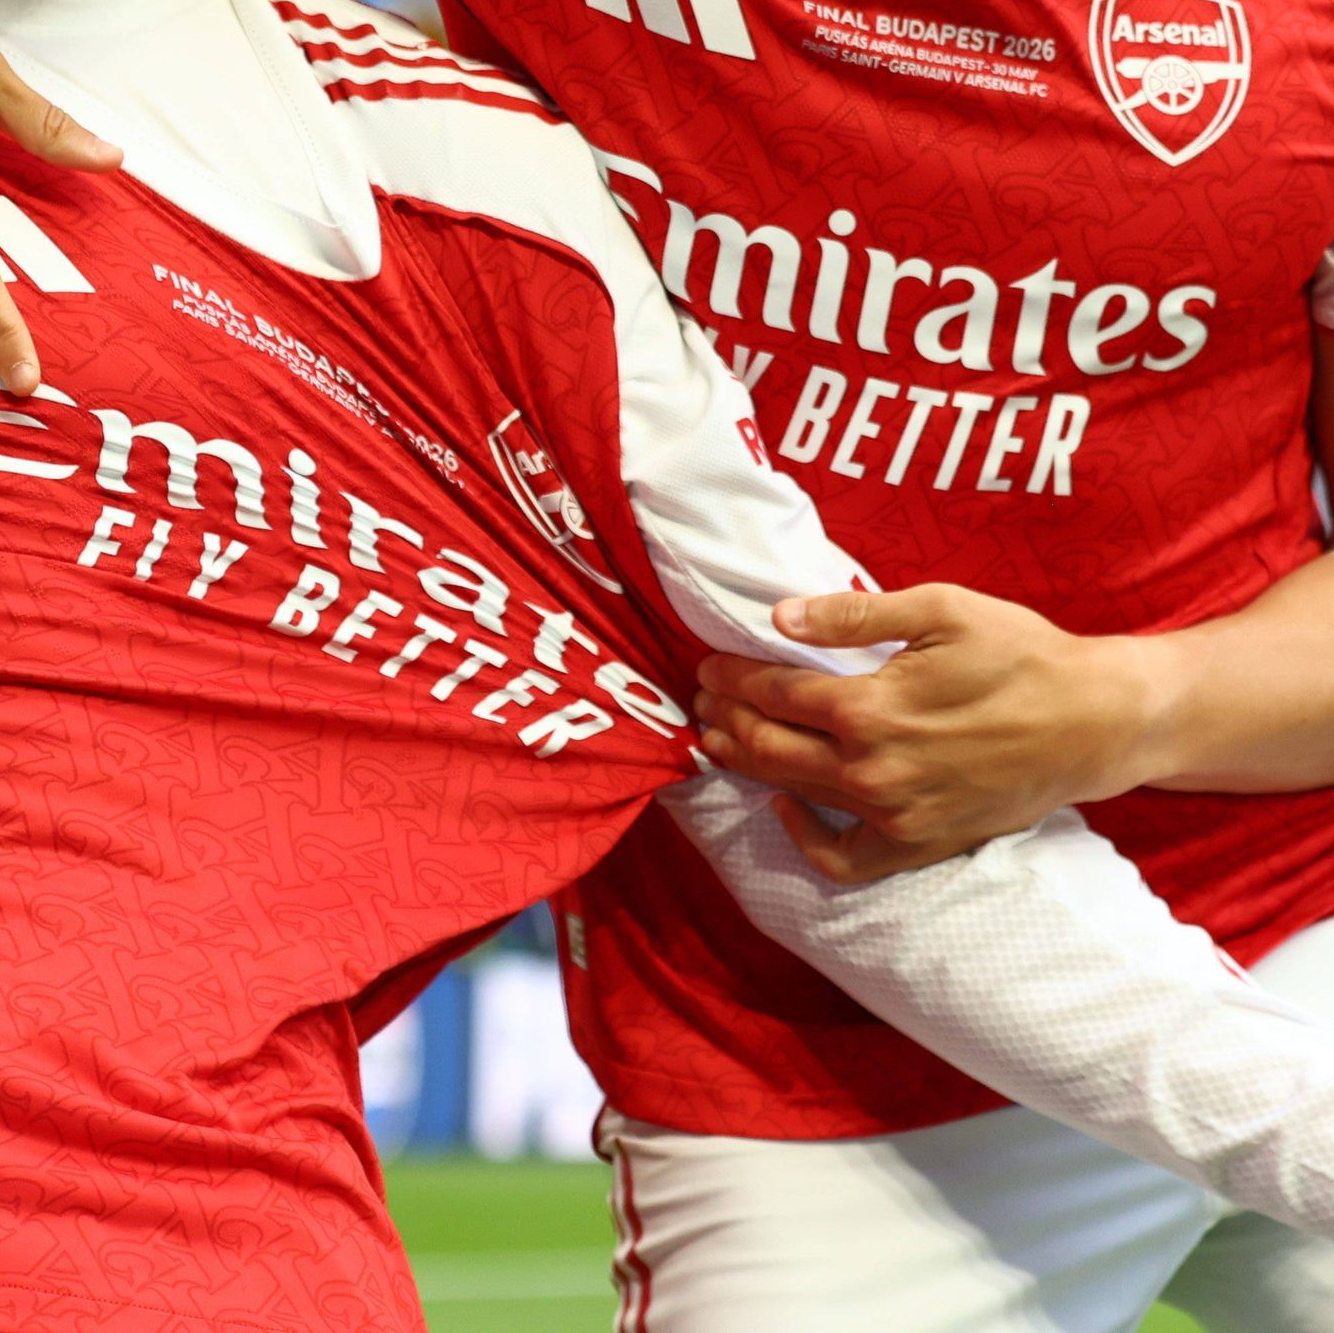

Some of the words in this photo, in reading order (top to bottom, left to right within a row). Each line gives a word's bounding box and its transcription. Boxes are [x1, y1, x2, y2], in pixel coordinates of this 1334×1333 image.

[803, 0, 870, 31] FINAL
[875, 15, 1000, 55] BUDAPEST
[1002, 35, 1056, 62] 2026
[815, 26, 868, 50] PUSKÁS
[869, 39, 915, 59] ARÉNA
[1008, 66, 1039, 81] MAY
[1112, 13, 1227, 47] Arsenal
[964, 73, 1028, 95] ARSENAL
[1028, 83, 1049, 98] FC
[153, 264, 247, 321] FINAL
[172, 299, 220, 328] PARIS
[778, 365, 1091, 496] BETTER
[268, 563, 615, 759] BETTER
